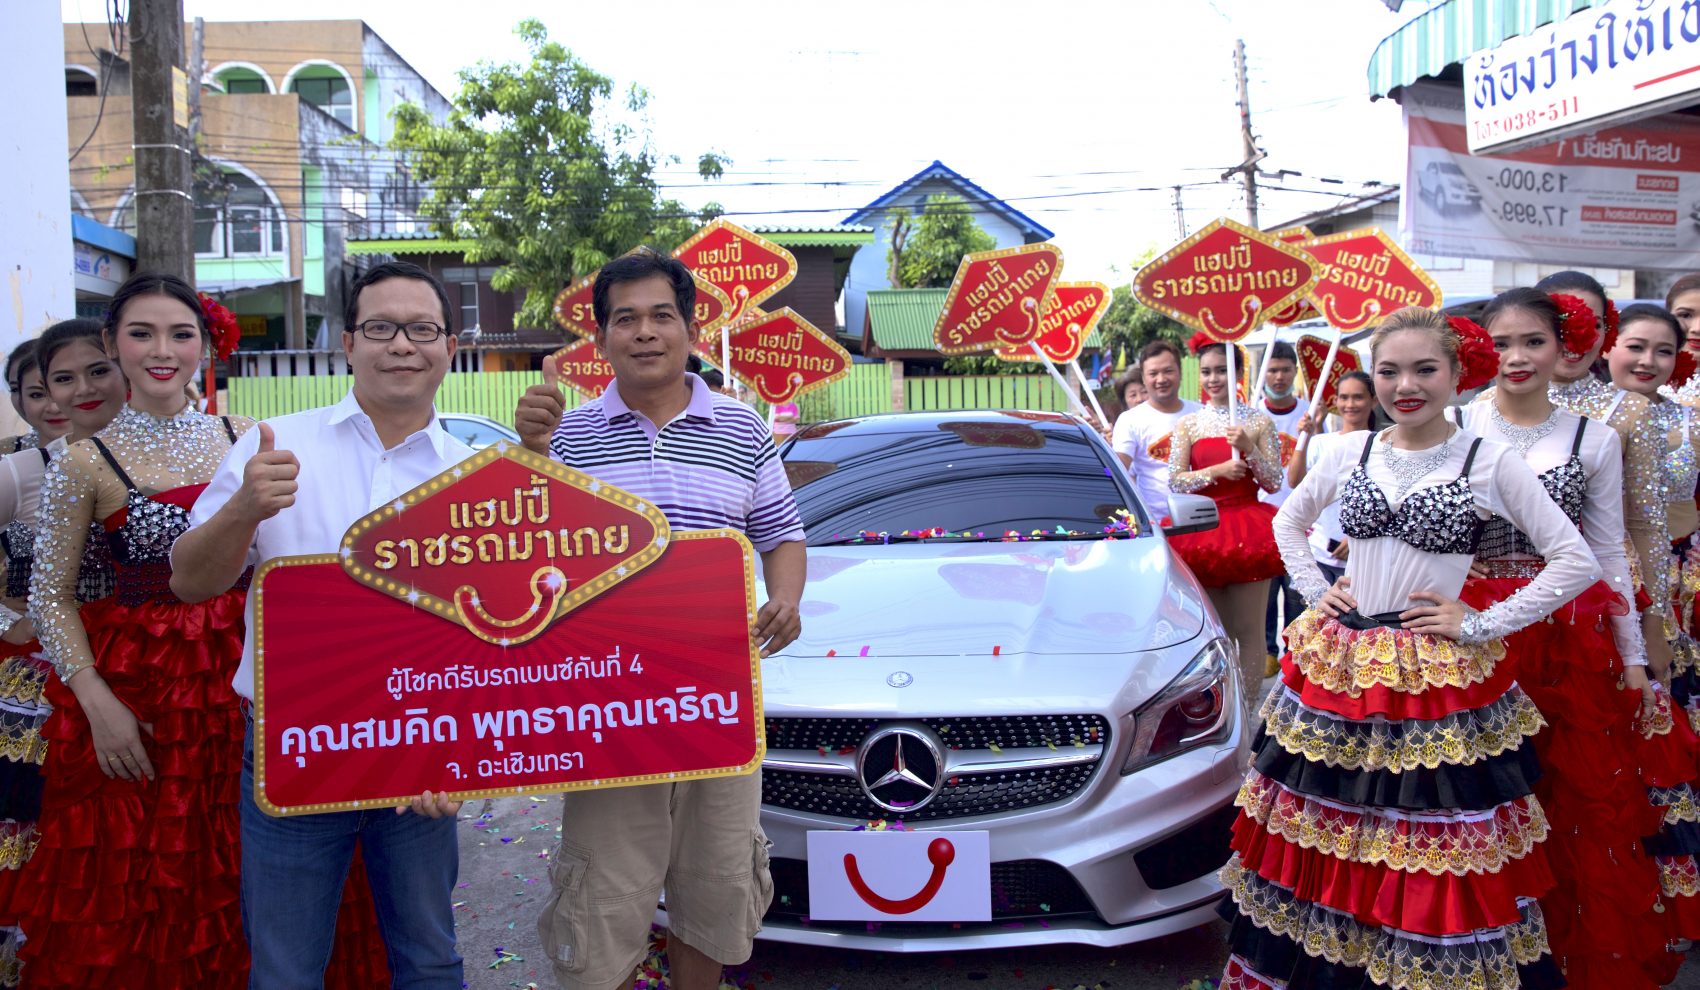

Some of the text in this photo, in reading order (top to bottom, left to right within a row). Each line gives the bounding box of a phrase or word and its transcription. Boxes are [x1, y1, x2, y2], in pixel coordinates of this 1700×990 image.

[698, 235, 742, 264] แฮปปี้
[1193, 237, 1251, 272] แฮปปี้
[1335, 249, 1393, 277] แฮปปี้
[693, 263, 778, 283] รถมาเกย
[965, 260, 1009, 308] แฮปปี้
[1152, 267, 1298, 299] ราชรถมาเกย
[1319, 262, 1422, 306] ชรถมาเกย
[948, 258, 1050, 345] ราชรถมาเกย
[758, 326, 804, 351] แฮปปี้
[450, 474, 549, 529] แฮปปี้
[374, 524, 629, 569] ราชรถมาเกย
[386, 645, 643, 700] ผู้โชคดีรับรถเบนซ์คันที่ 4
[281, 686, 739, 768] คุณสมคิด พุทธาคุณเจริญ
[446, 752, 584, 779] จ. ฉะเชิงเทรา
